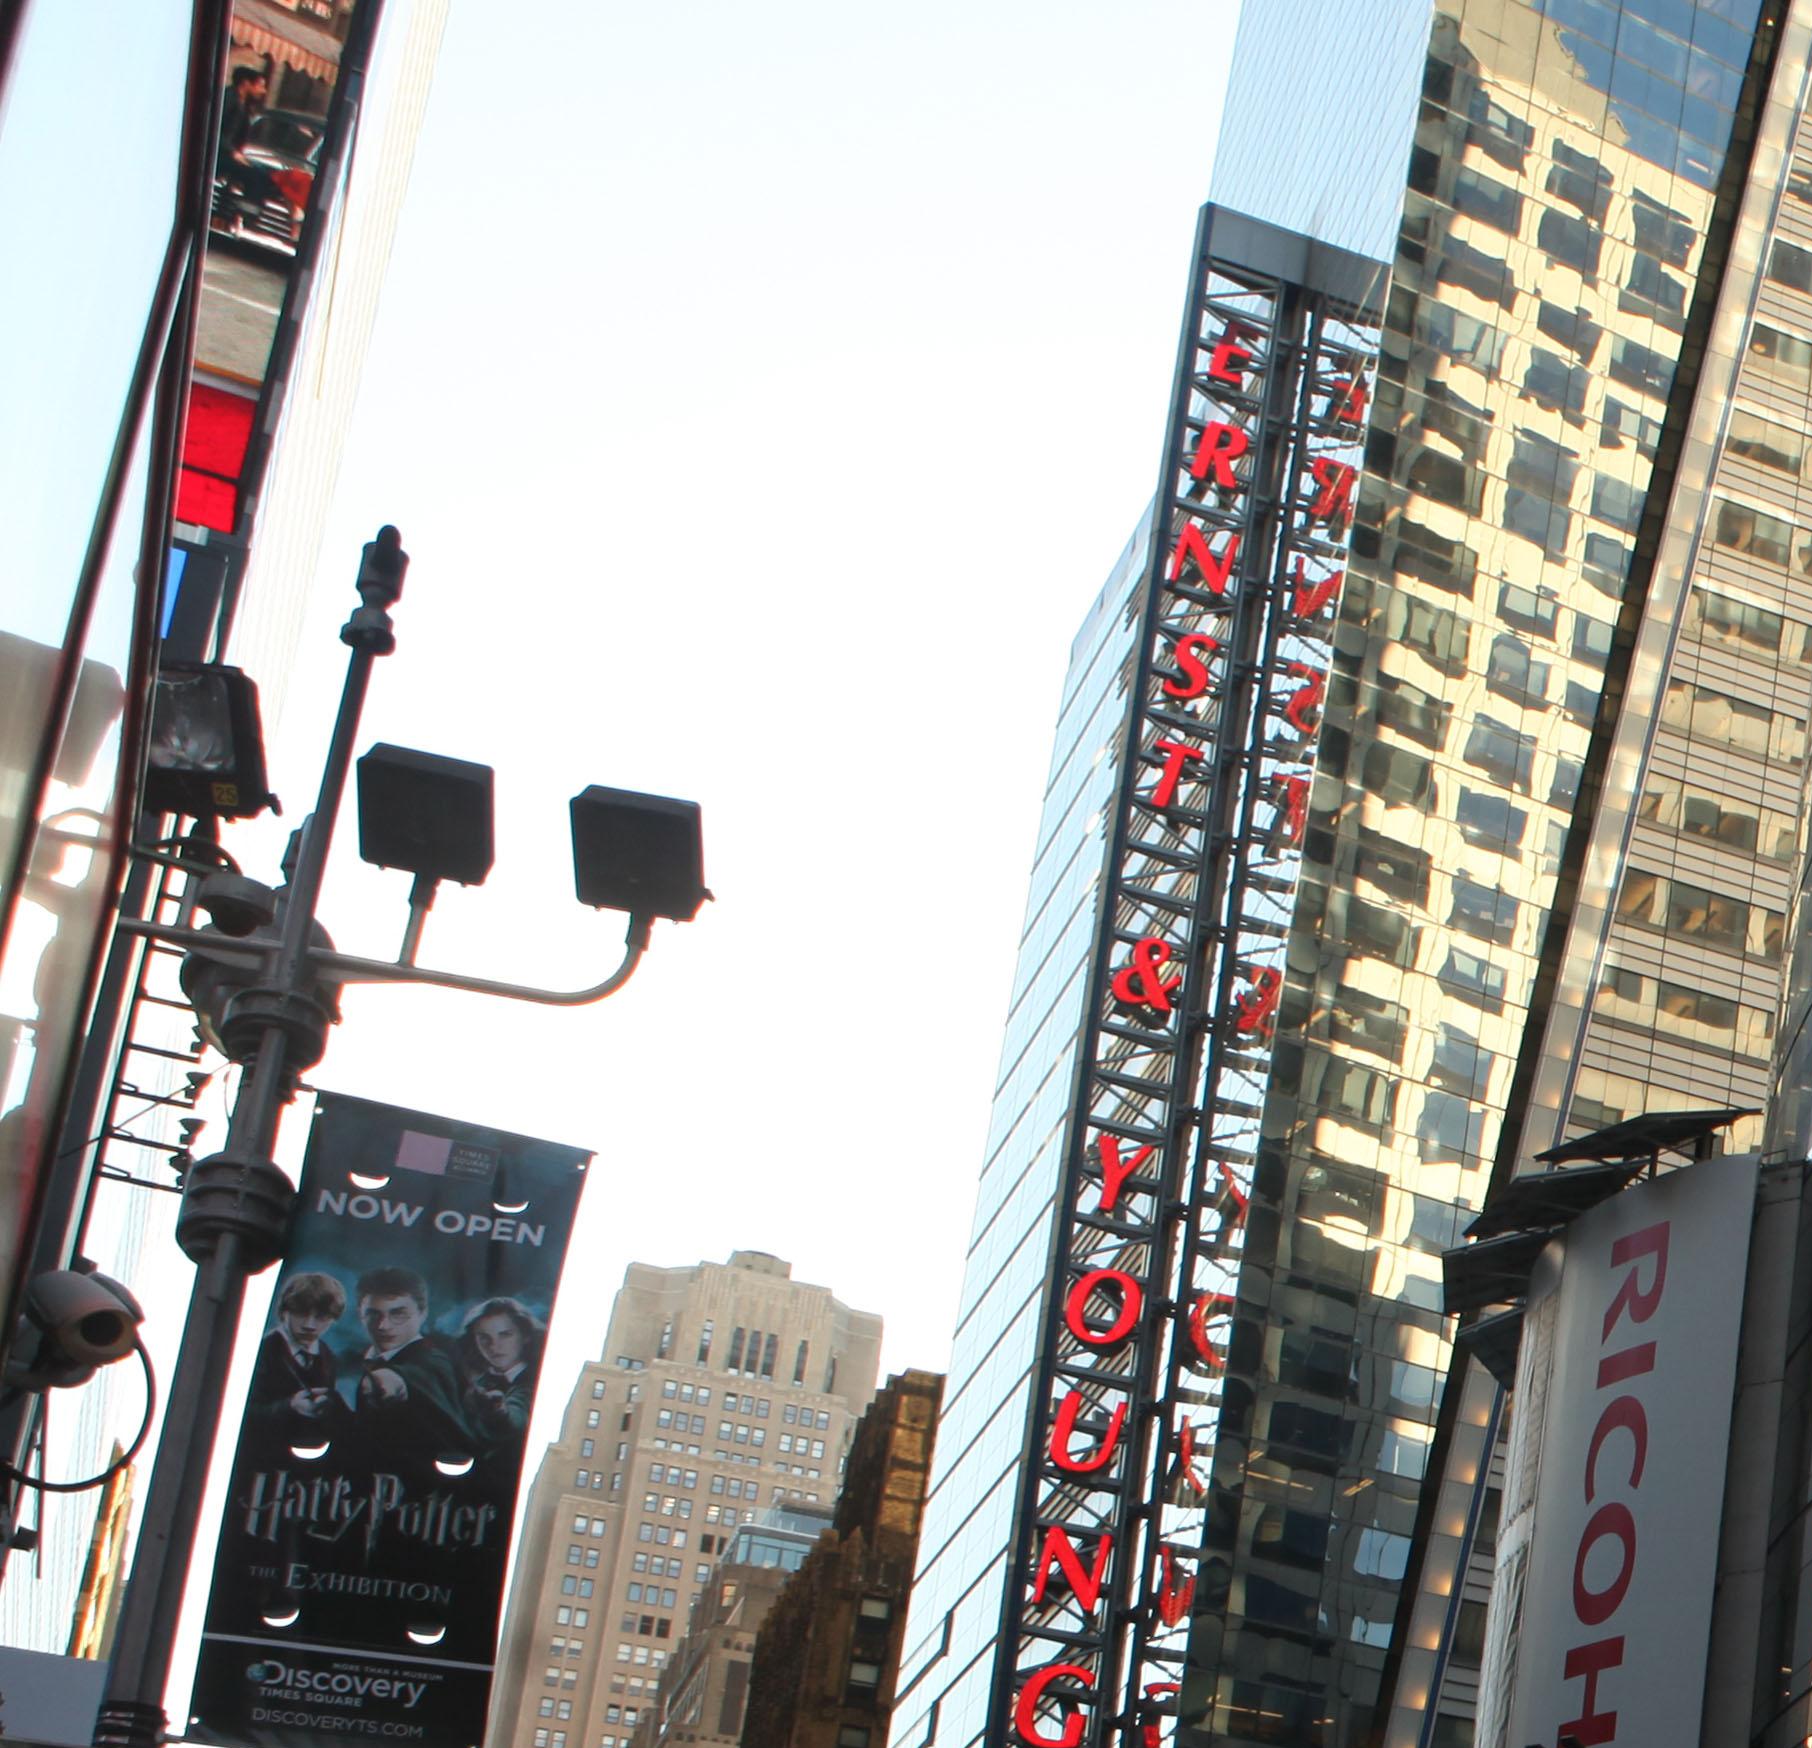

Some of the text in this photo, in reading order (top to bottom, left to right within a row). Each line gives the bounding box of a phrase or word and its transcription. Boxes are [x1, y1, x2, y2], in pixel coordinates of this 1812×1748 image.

[1151, 321, 1259, 808] ERNST
[1112, 937, 1181, 1012] &
[317, 1189, 545, 1247] NOW OPEN
[238, 1470, 496, 1565] Harry Potter
[252, 1708, 423, 1738] DISCOVERYTS.COM
[260, 1687, 364, 1707] TIMES SQUARE
